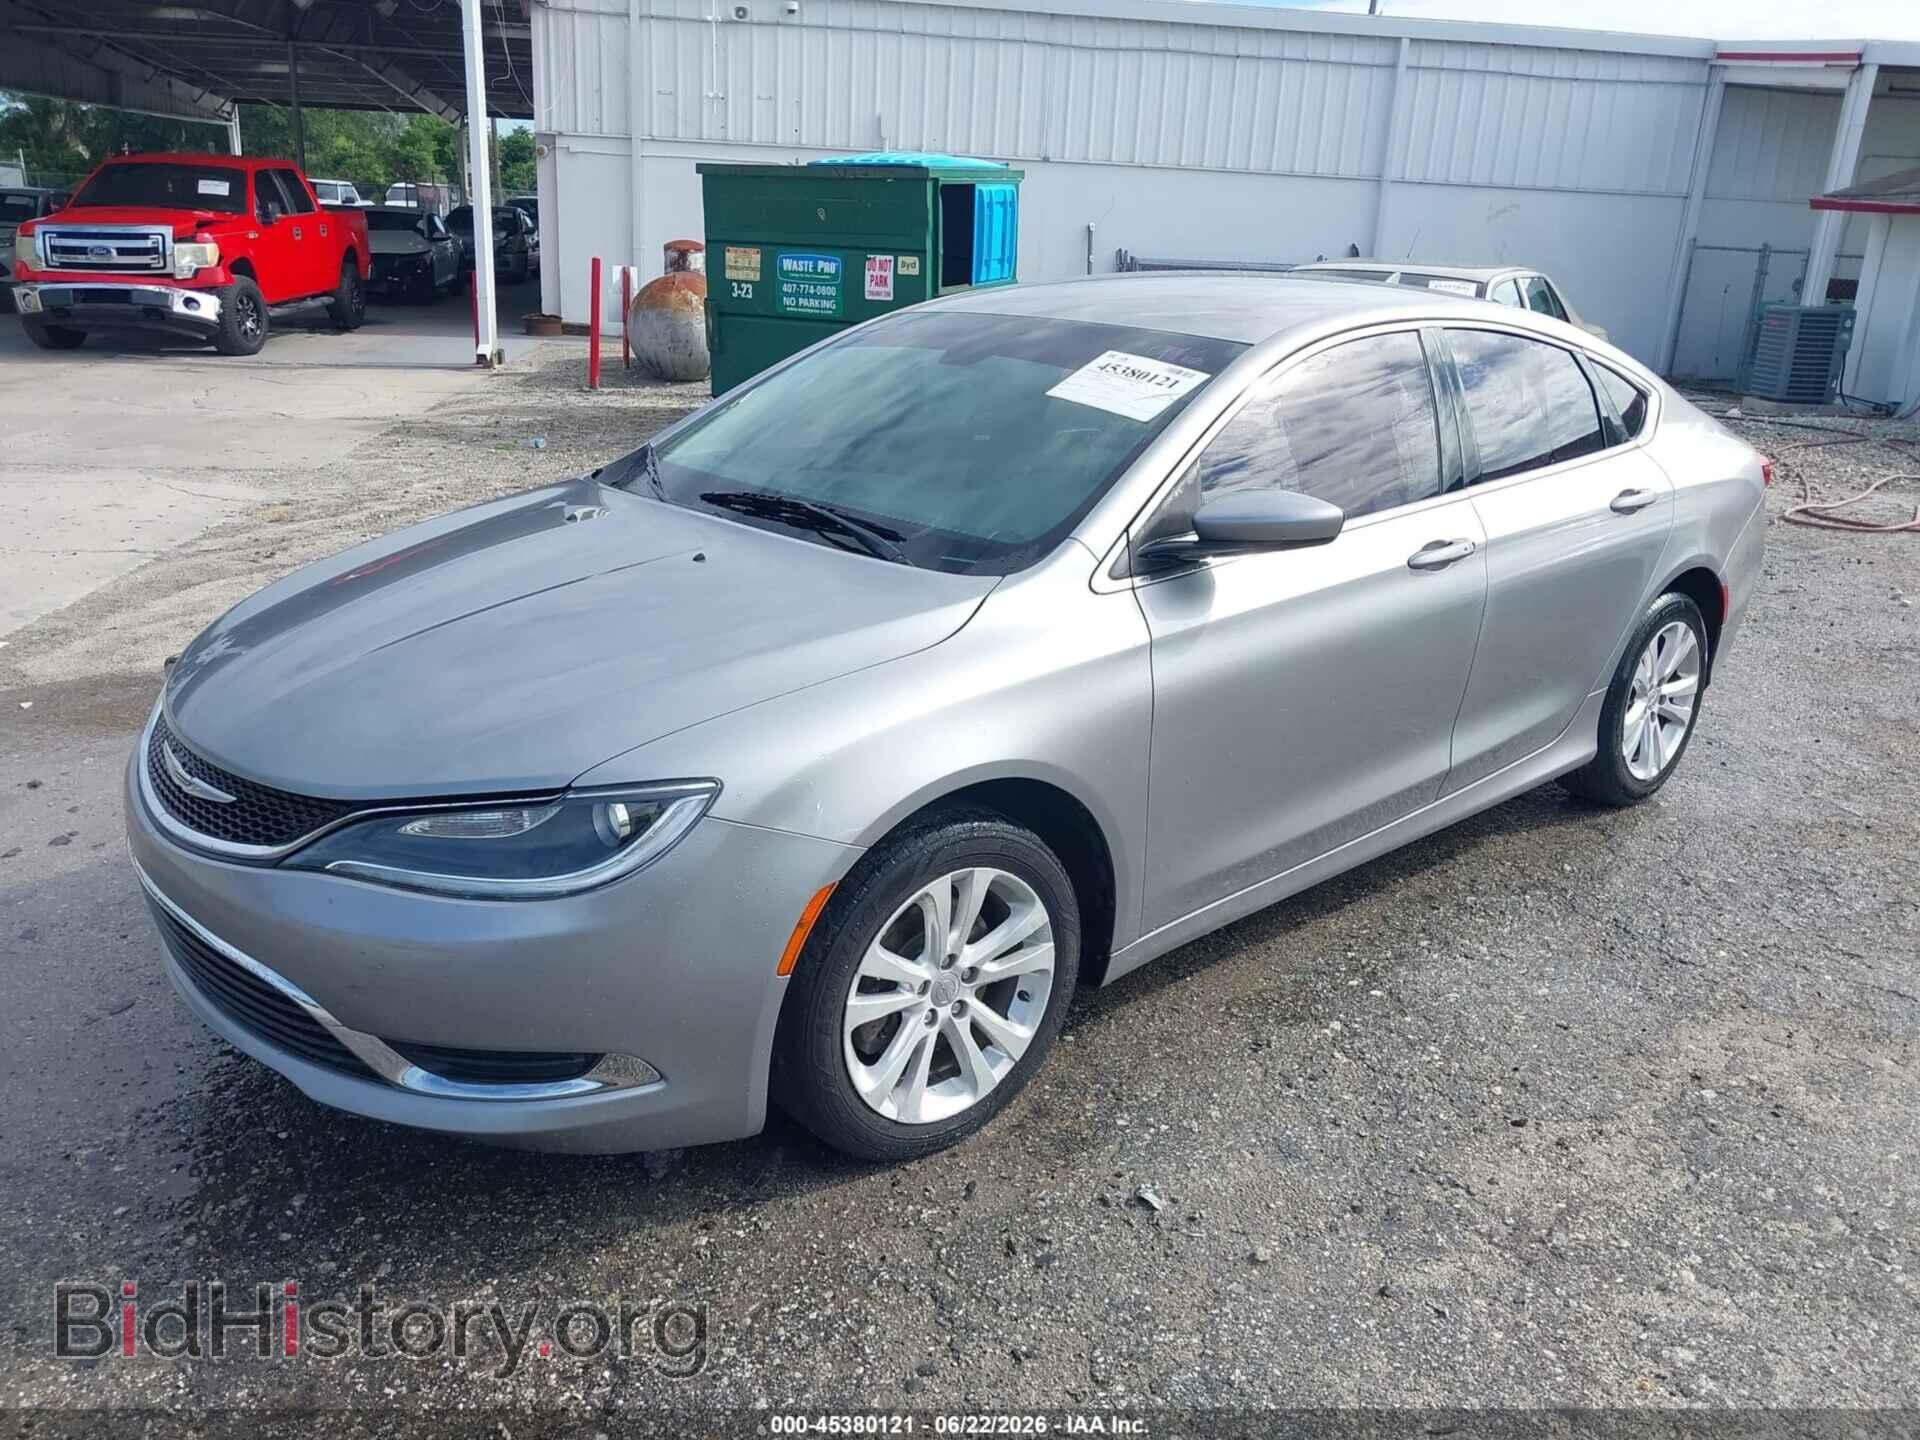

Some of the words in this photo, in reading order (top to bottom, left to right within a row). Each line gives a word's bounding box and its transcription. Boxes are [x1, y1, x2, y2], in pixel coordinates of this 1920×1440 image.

[783, 258, 814, 272] WASTE
[867, 256, 877, 272] DO
[879, 259, 892, 272] NOT
[870, 274, 888, 288] PARK
[731, 282, 753, 299] 3-23
[783, 296, 796, 306] NO
[798, 297, 837, 310] PARKING
[1098, 362, 1179, 388] 45380121
